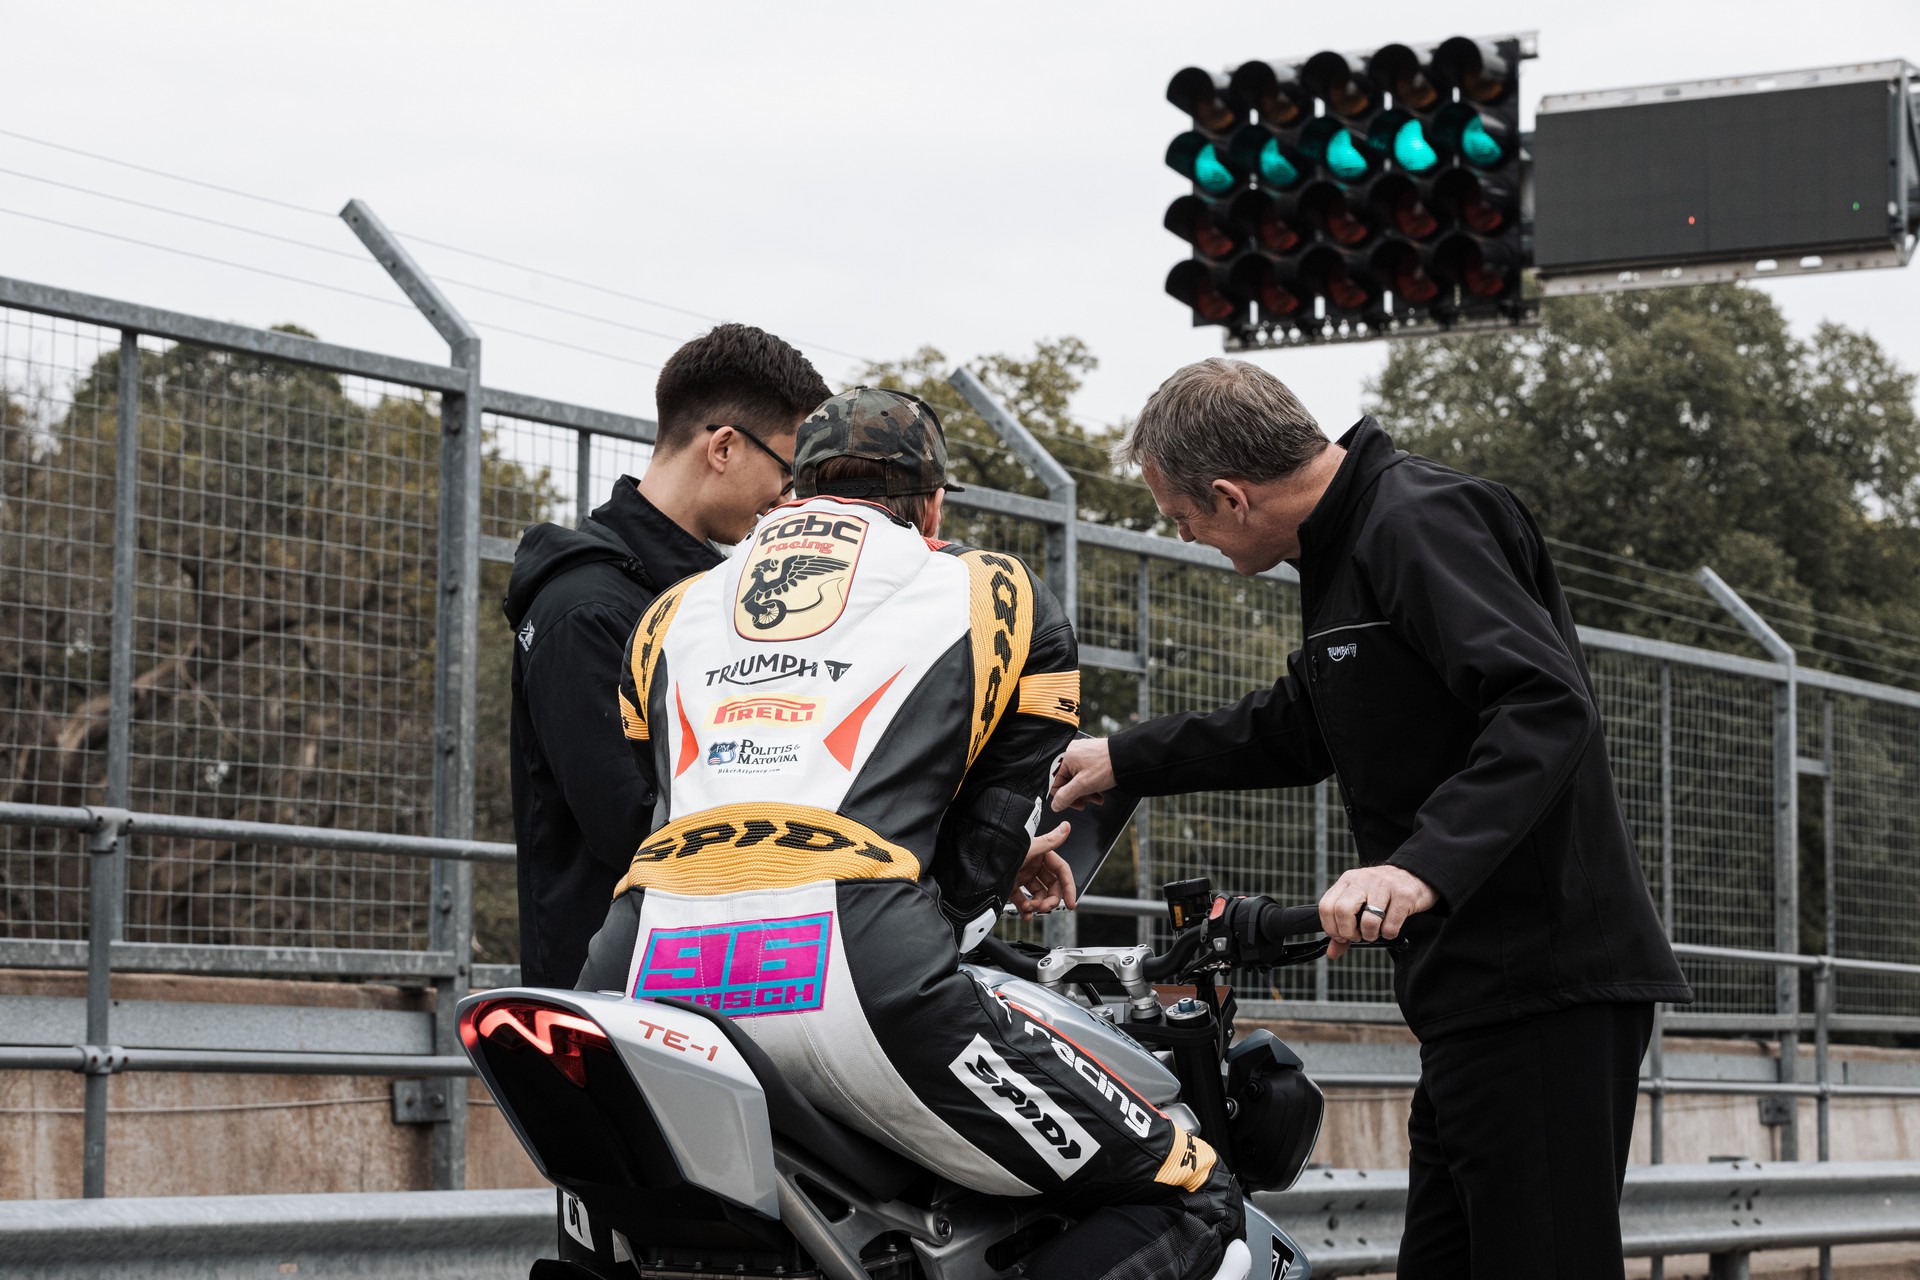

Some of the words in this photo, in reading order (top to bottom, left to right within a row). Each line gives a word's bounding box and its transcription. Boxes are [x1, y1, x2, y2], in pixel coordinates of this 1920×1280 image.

[765, 539, 835, 555] racing
[705, 653, 819, 686] TRIUMPH
[713, 698, 816, 724] PIRELLI
[737, 753, 798, 765] MATOVINA
[632, 819, 894, 864] SPIDI
[642, 922, 822, 991] 96
[638, 1020, 719, 1062] TE-1
[1024, 1020, 1152, 1138] racing
[964, 1054, 1082, 1160] SPIDI
